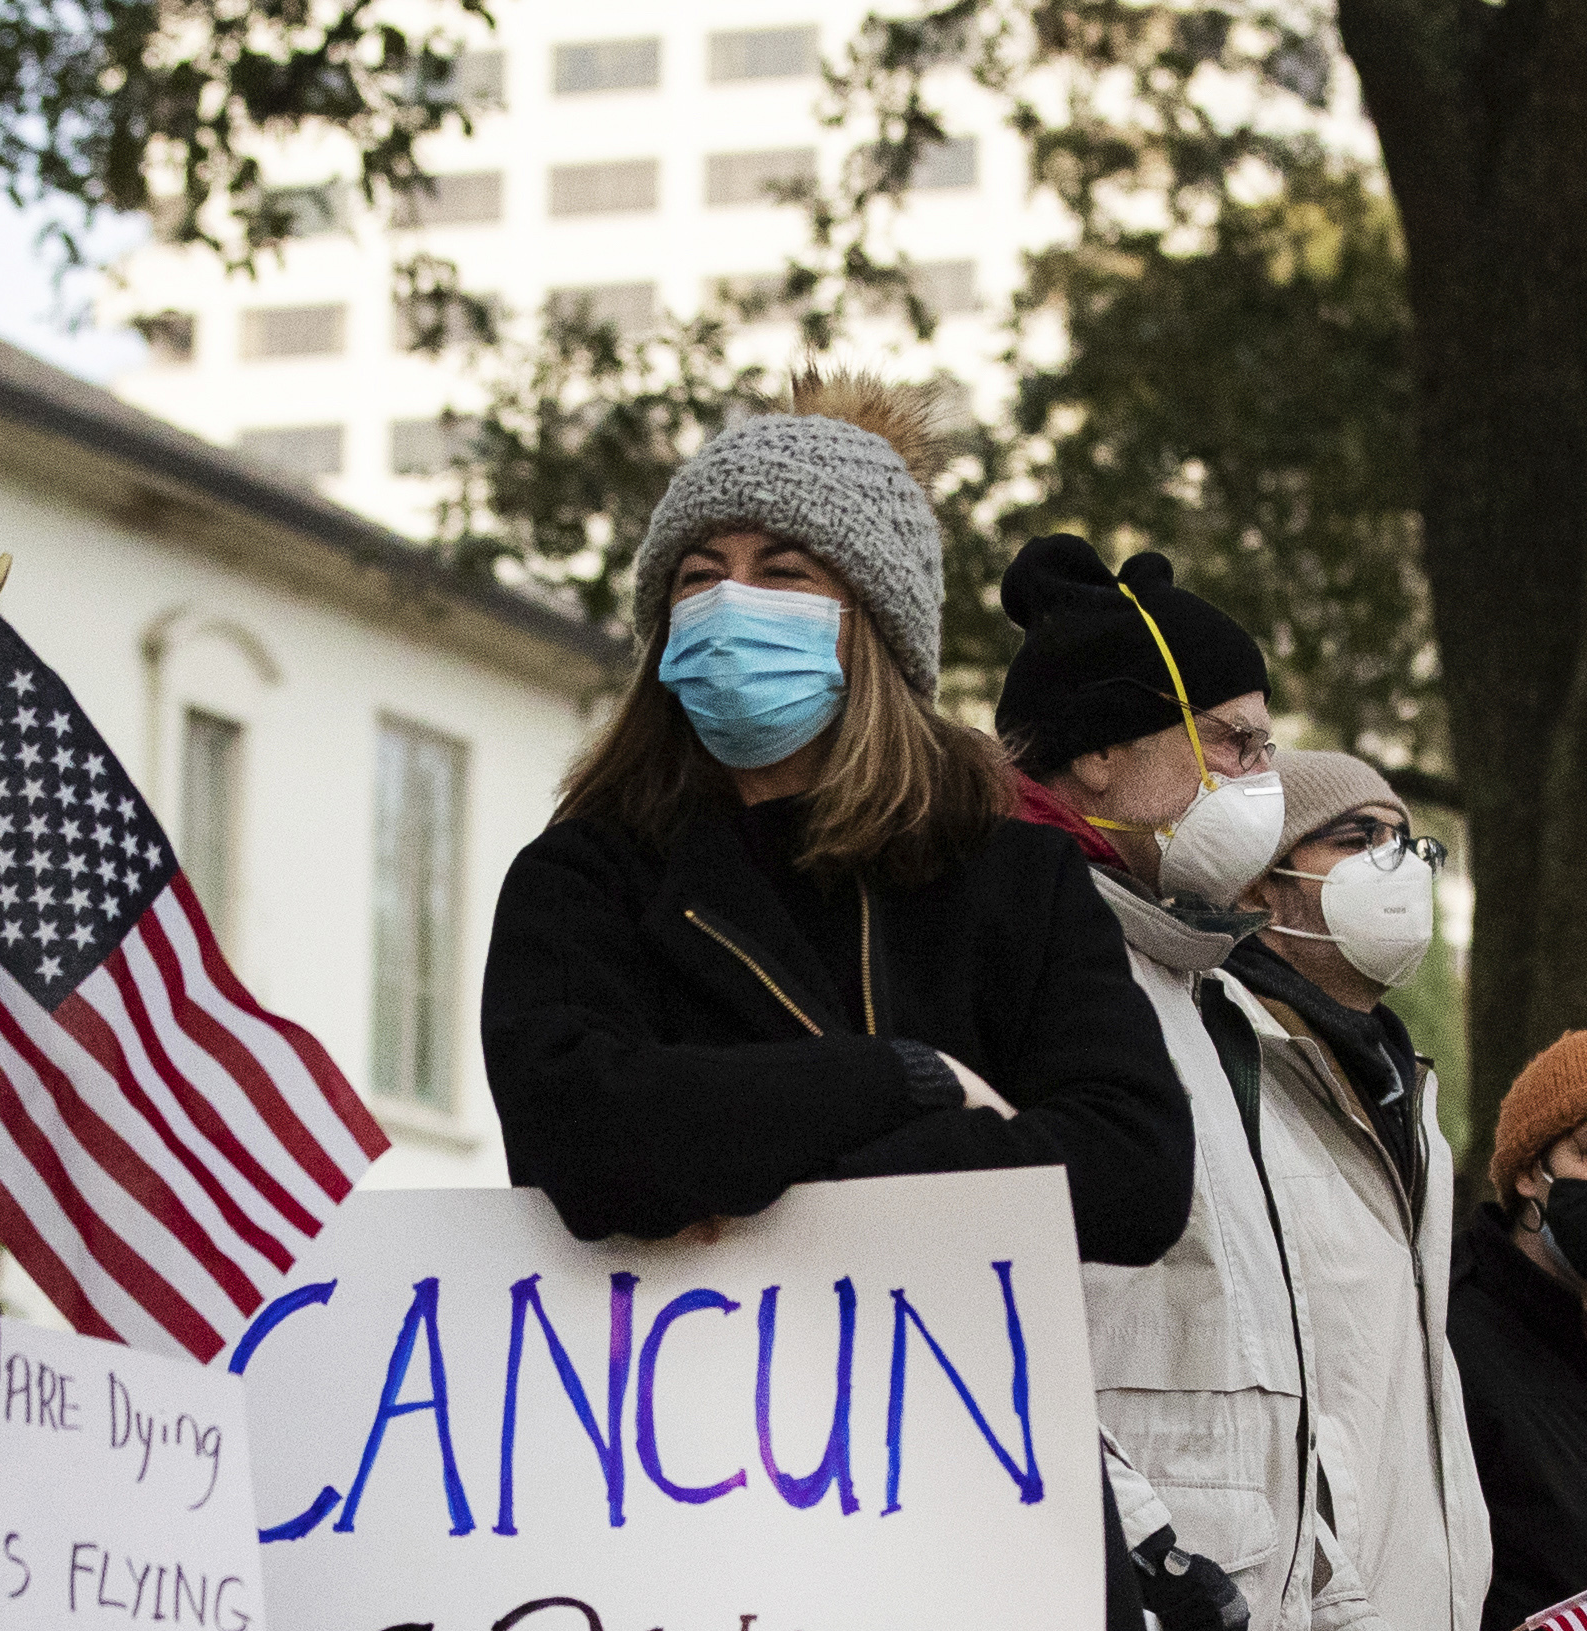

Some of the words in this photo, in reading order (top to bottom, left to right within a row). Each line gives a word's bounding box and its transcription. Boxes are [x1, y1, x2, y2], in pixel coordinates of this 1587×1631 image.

[4, 1352, 83, 1432] ARE
[108, 1371, 223, 1511] Dying
[228, 1259, 1045, 1544] CANCUN
